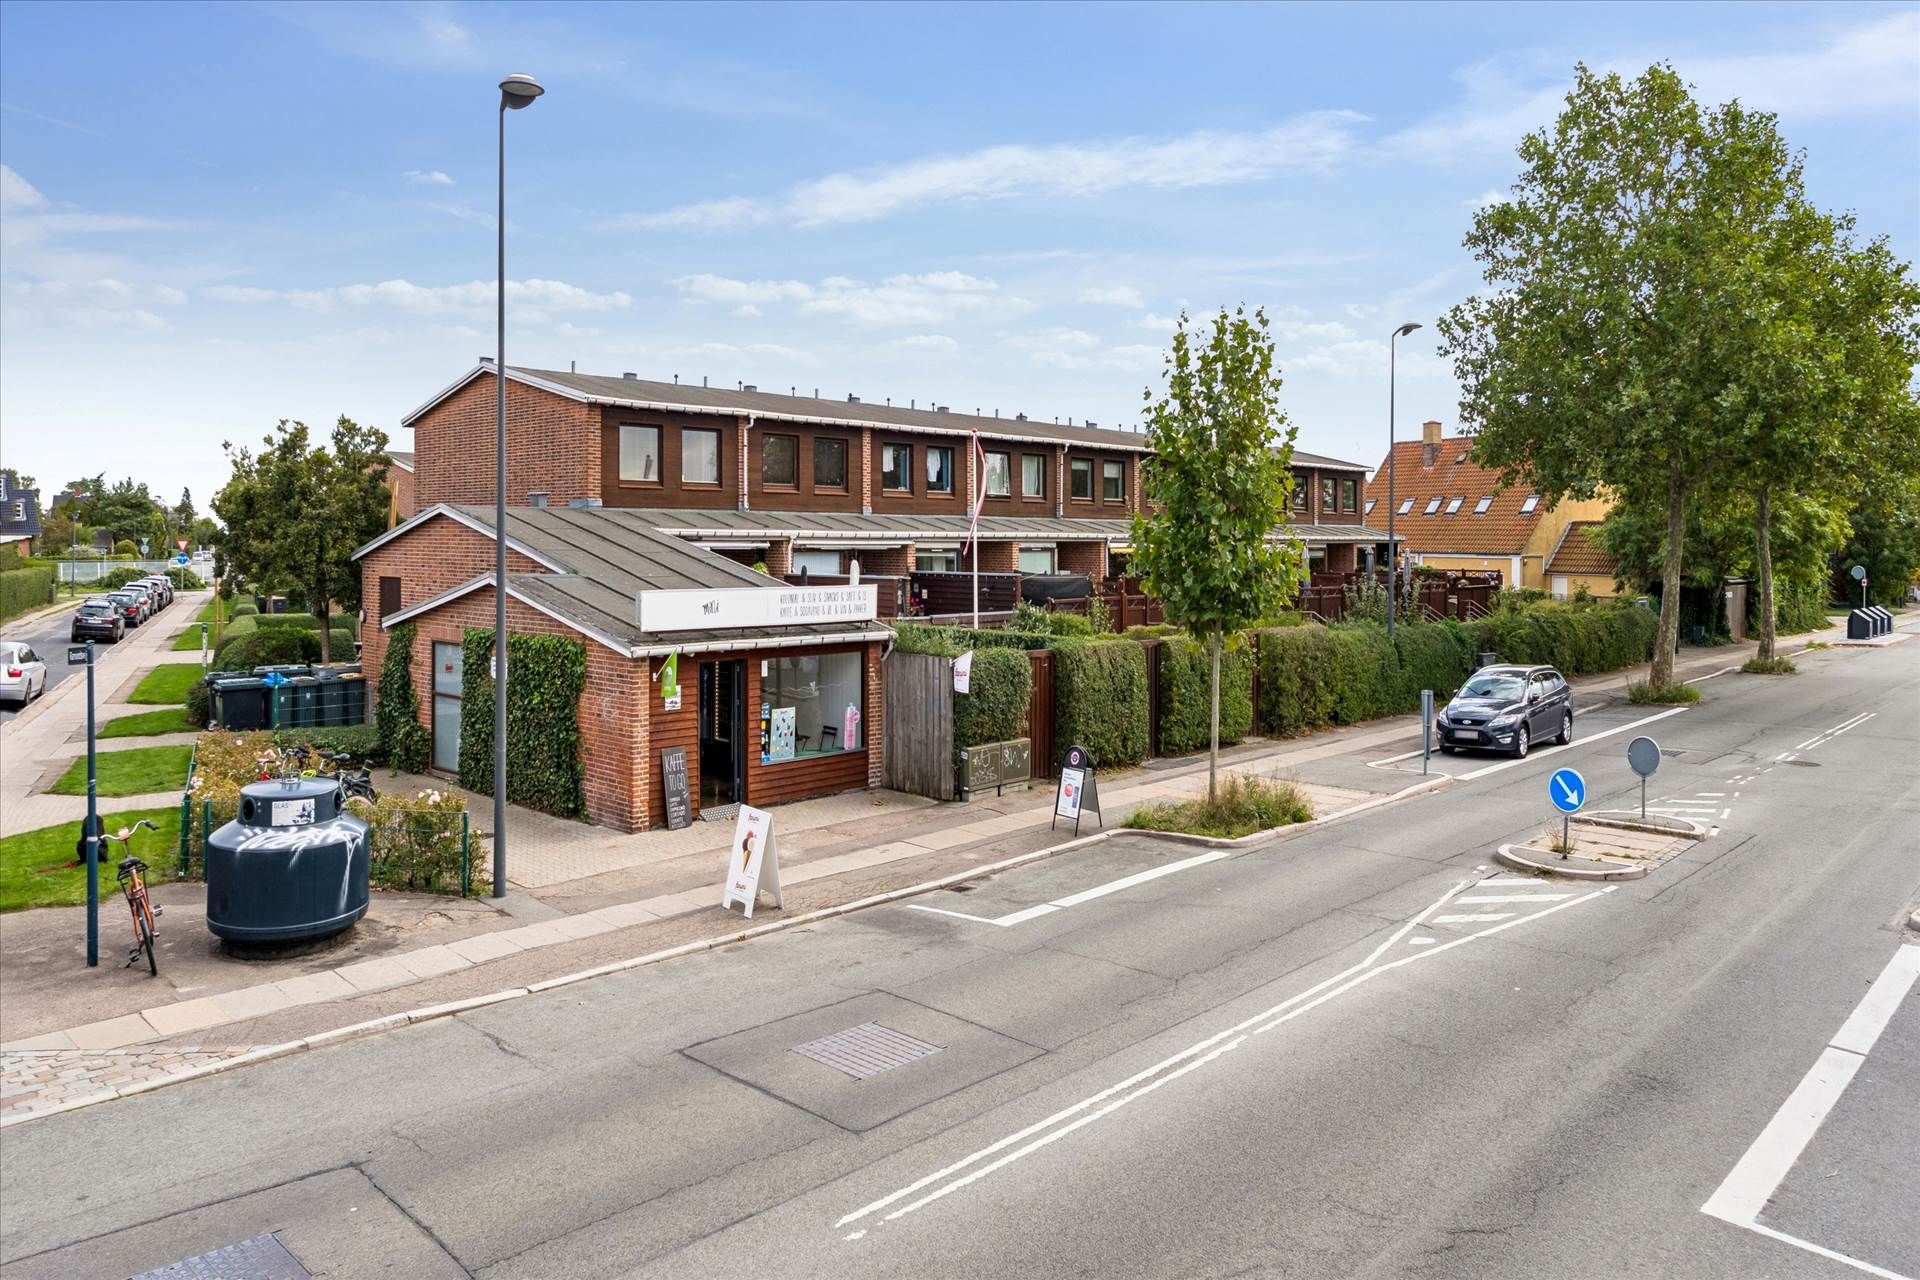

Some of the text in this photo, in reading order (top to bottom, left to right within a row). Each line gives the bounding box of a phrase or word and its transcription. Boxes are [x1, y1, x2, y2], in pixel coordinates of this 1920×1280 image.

[664, 753, 685, 773] KAFFE
[669, 773, 686, 791] TO GO
